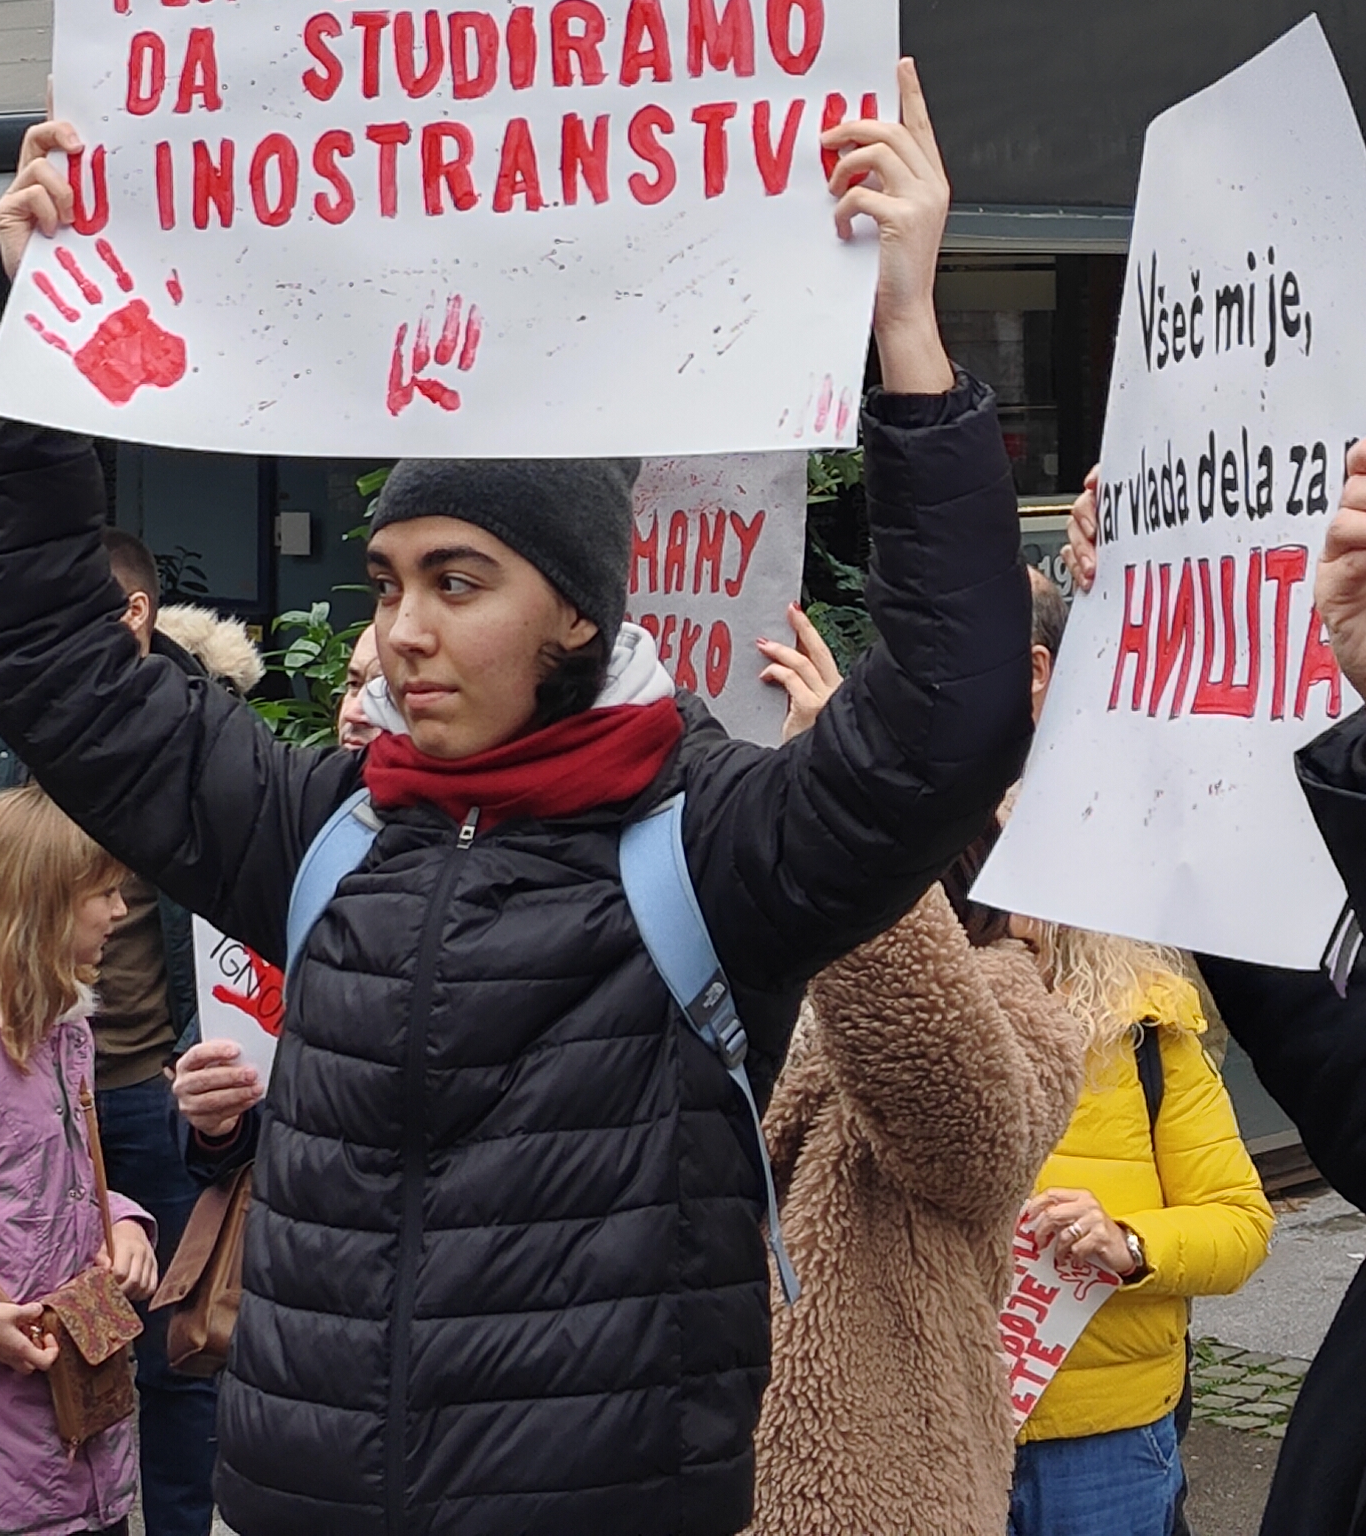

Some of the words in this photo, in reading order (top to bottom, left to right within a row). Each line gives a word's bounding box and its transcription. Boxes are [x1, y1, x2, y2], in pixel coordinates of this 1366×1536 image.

[126, 27, 223, 116] DA
[67, 143, 109, 236] U
[1138, 249, 1204, 372] Všeč
[1264, 246, 1312, 367] je,
[1129, 439, 1189, 535] vlada
[1198, 425, 1273, 523] dela
[1286, 441, 1328, 516] za
[624, 611, 732, 699] EKO
[1107, 544, 1342, 721] НИШТА
[210, 935, 286, 1029] IGNO
